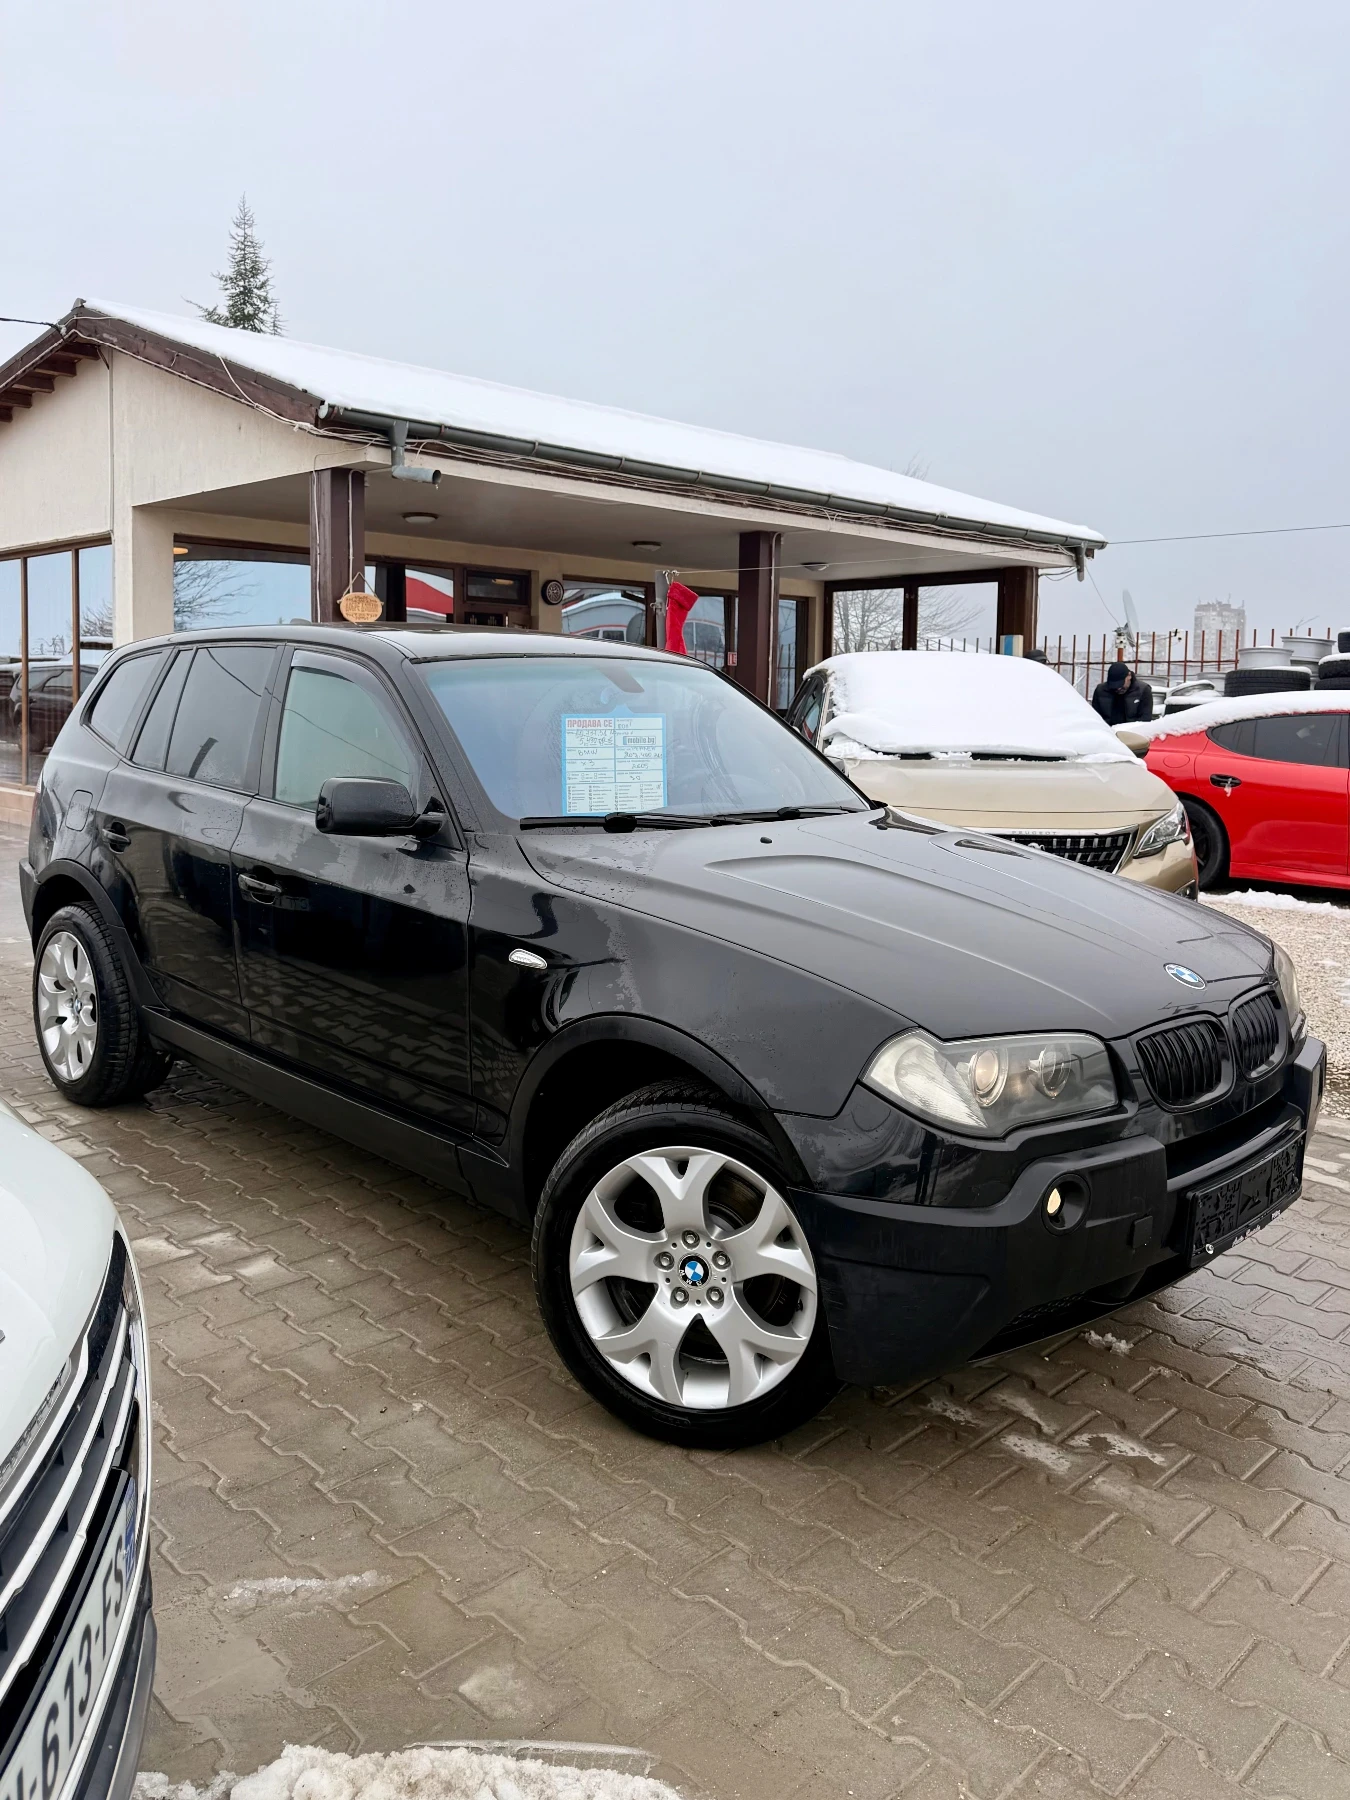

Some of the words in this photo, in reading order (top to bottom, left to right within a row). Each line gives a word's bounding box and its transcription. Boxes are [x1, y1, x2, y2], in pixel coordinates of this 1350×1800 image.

[567, 719, 602, 728] ПРОДАВА
[603, 719, 613, 728] СЕ
[627, 736, 655, 745] mobile.bg
[578, 748, 598, 757] BMW
